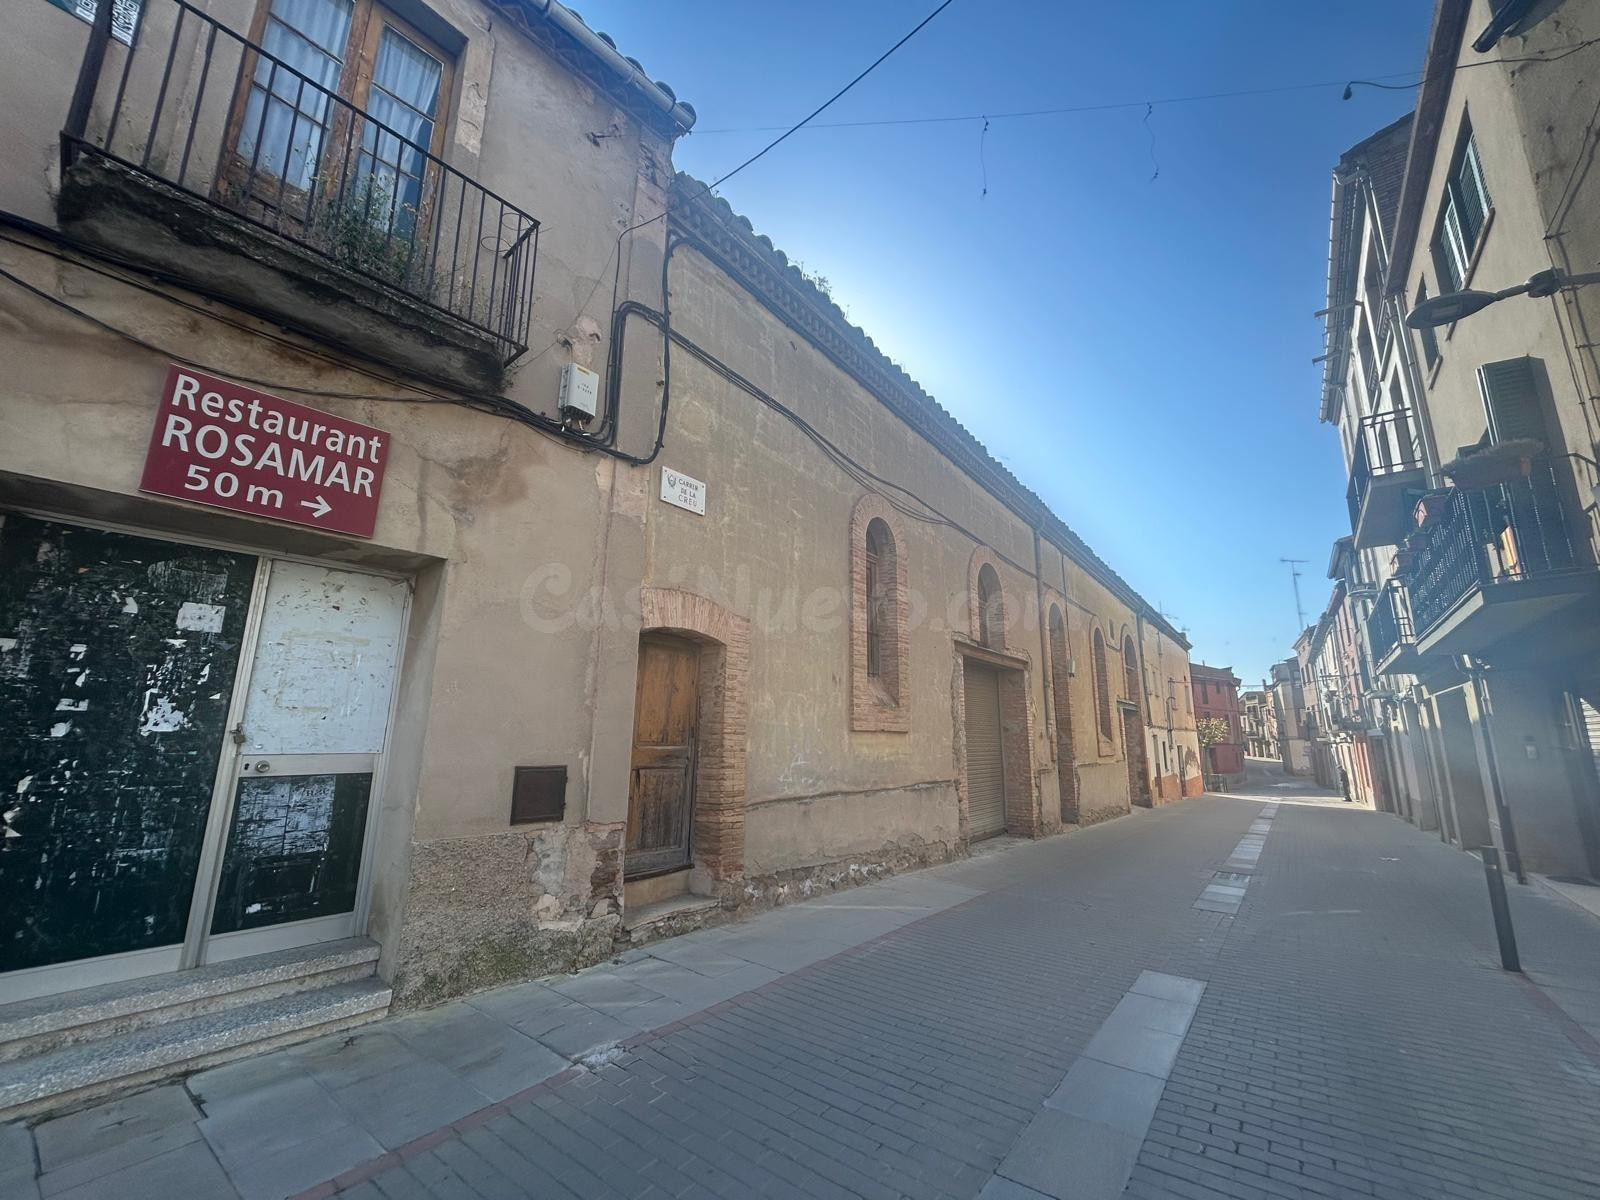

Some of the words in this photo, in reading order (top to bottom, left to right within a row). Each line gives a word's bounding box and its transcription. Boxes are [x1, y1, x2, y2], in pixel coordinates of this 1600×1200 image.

[171, 373, 382, 464] Restaurant
[161, 414, 375, 498] ROSAMAR
[184, 464, 239, 498] 50
[246, 484, 284, 509] m
[690, 491, 696, 499] LA
